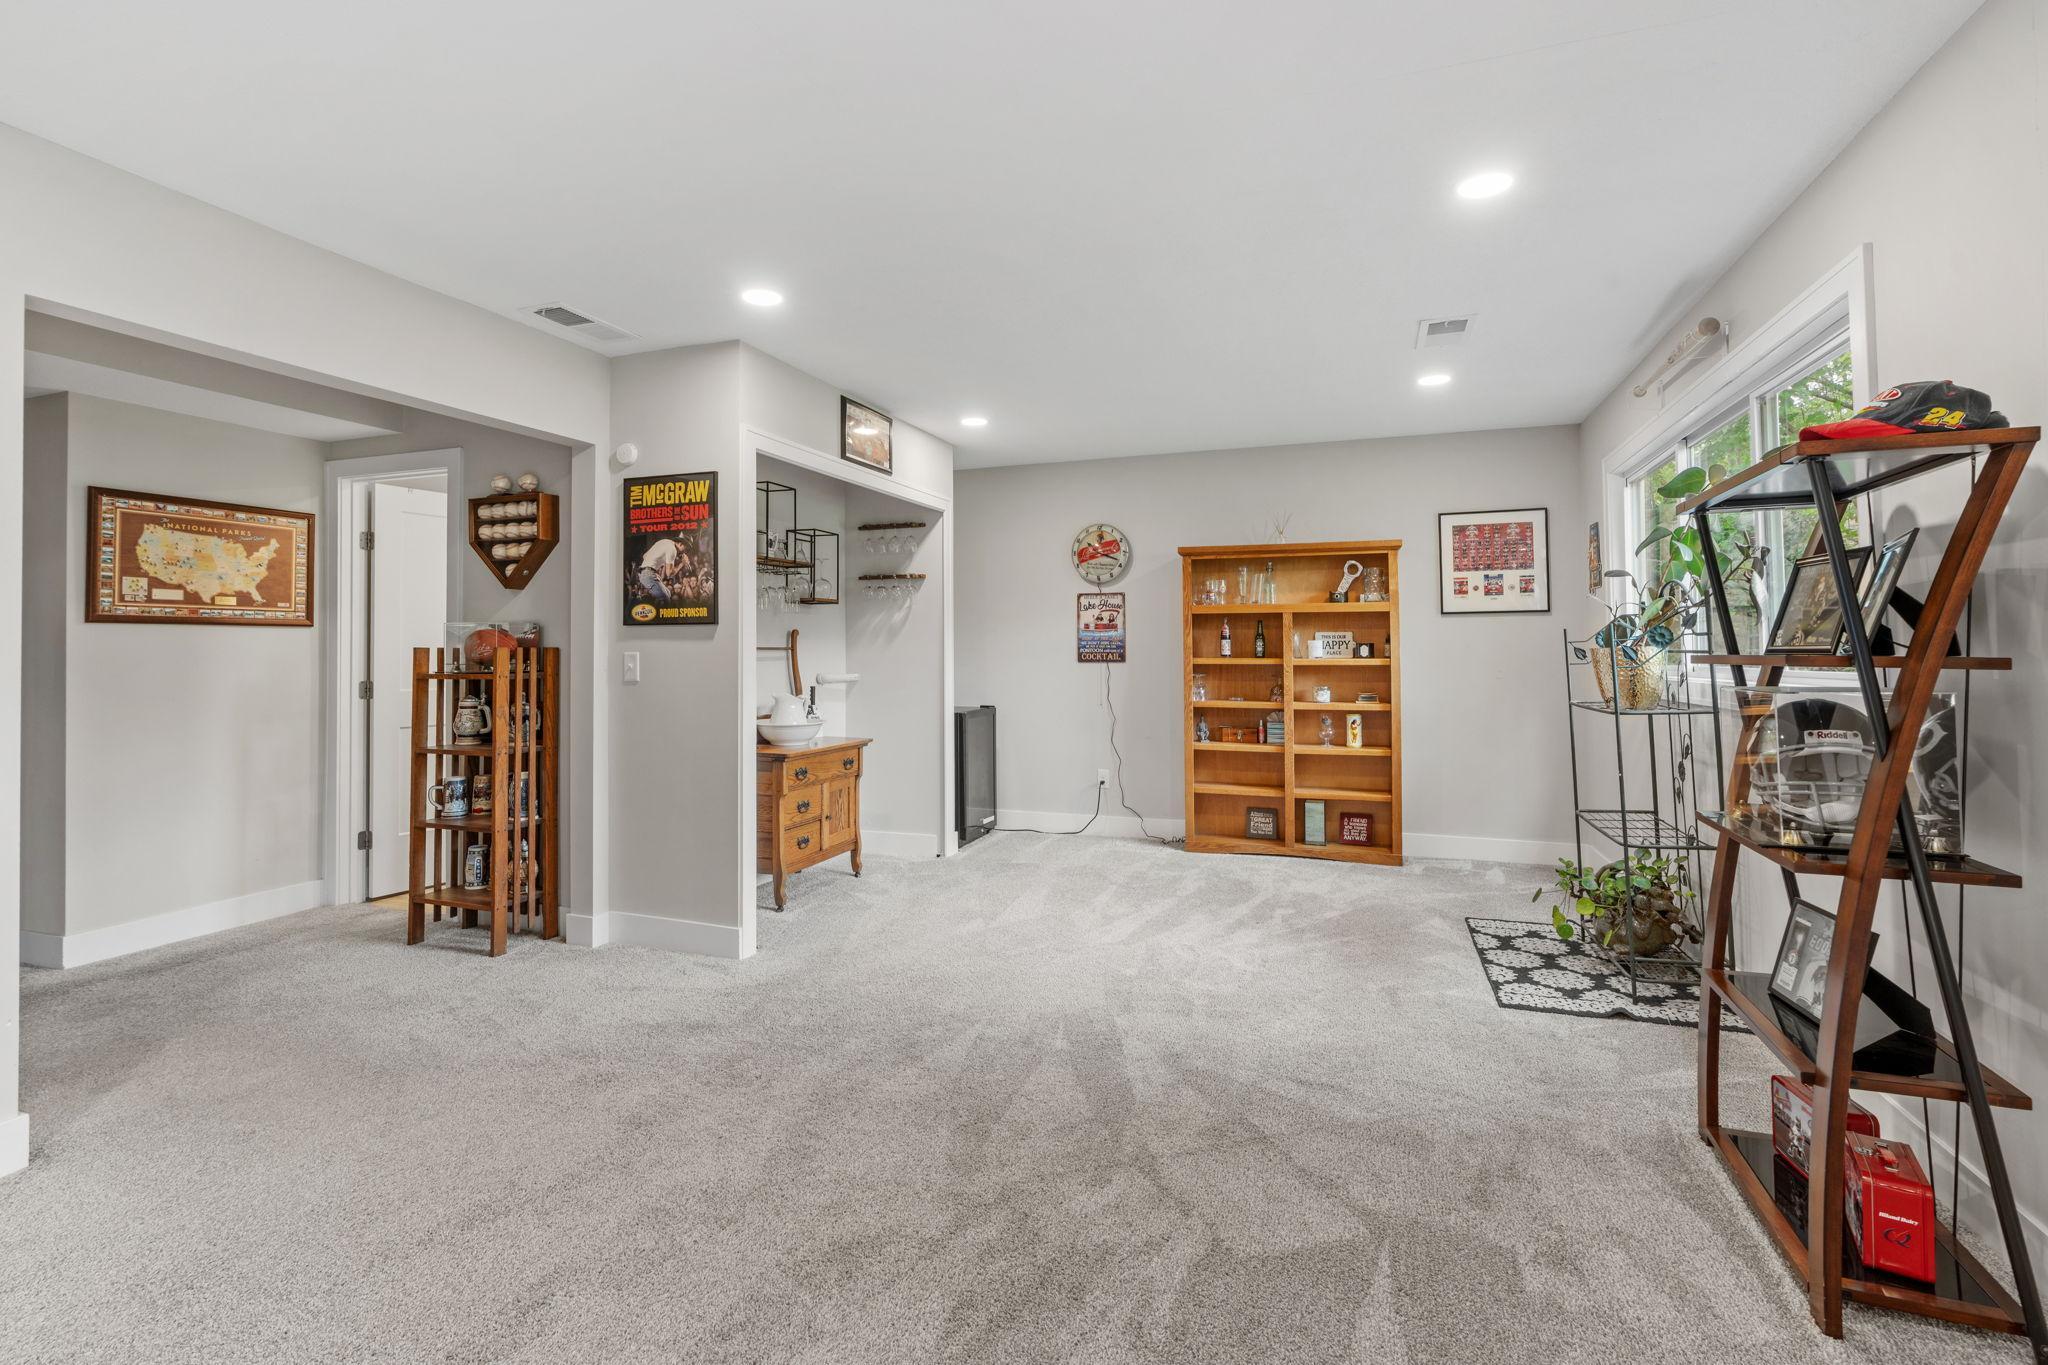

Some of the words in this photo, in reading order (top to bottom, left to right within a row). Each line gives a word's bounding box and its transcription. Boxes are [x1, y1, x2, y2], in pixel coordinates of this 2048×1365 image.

[1918, 407, 1966, 429] 24
[630, 486, 642, 507] TIM
[630, 506, 673, 519] BROTHERS
[681, 504, 709, 520] SUN
[222, 528, 252, 536] PARKS
[640, 524, 667, 532] TOUR
[671, 522, 698, 531] 2012
[1079, 601, 1097, 611] Lake
[1097, 599, 1123, 610] House
[660, 608, 679, 617] PROUD
[679, 607, 708, 617] SPONSOR
[1817, 731, 1848, 740] Riddell
